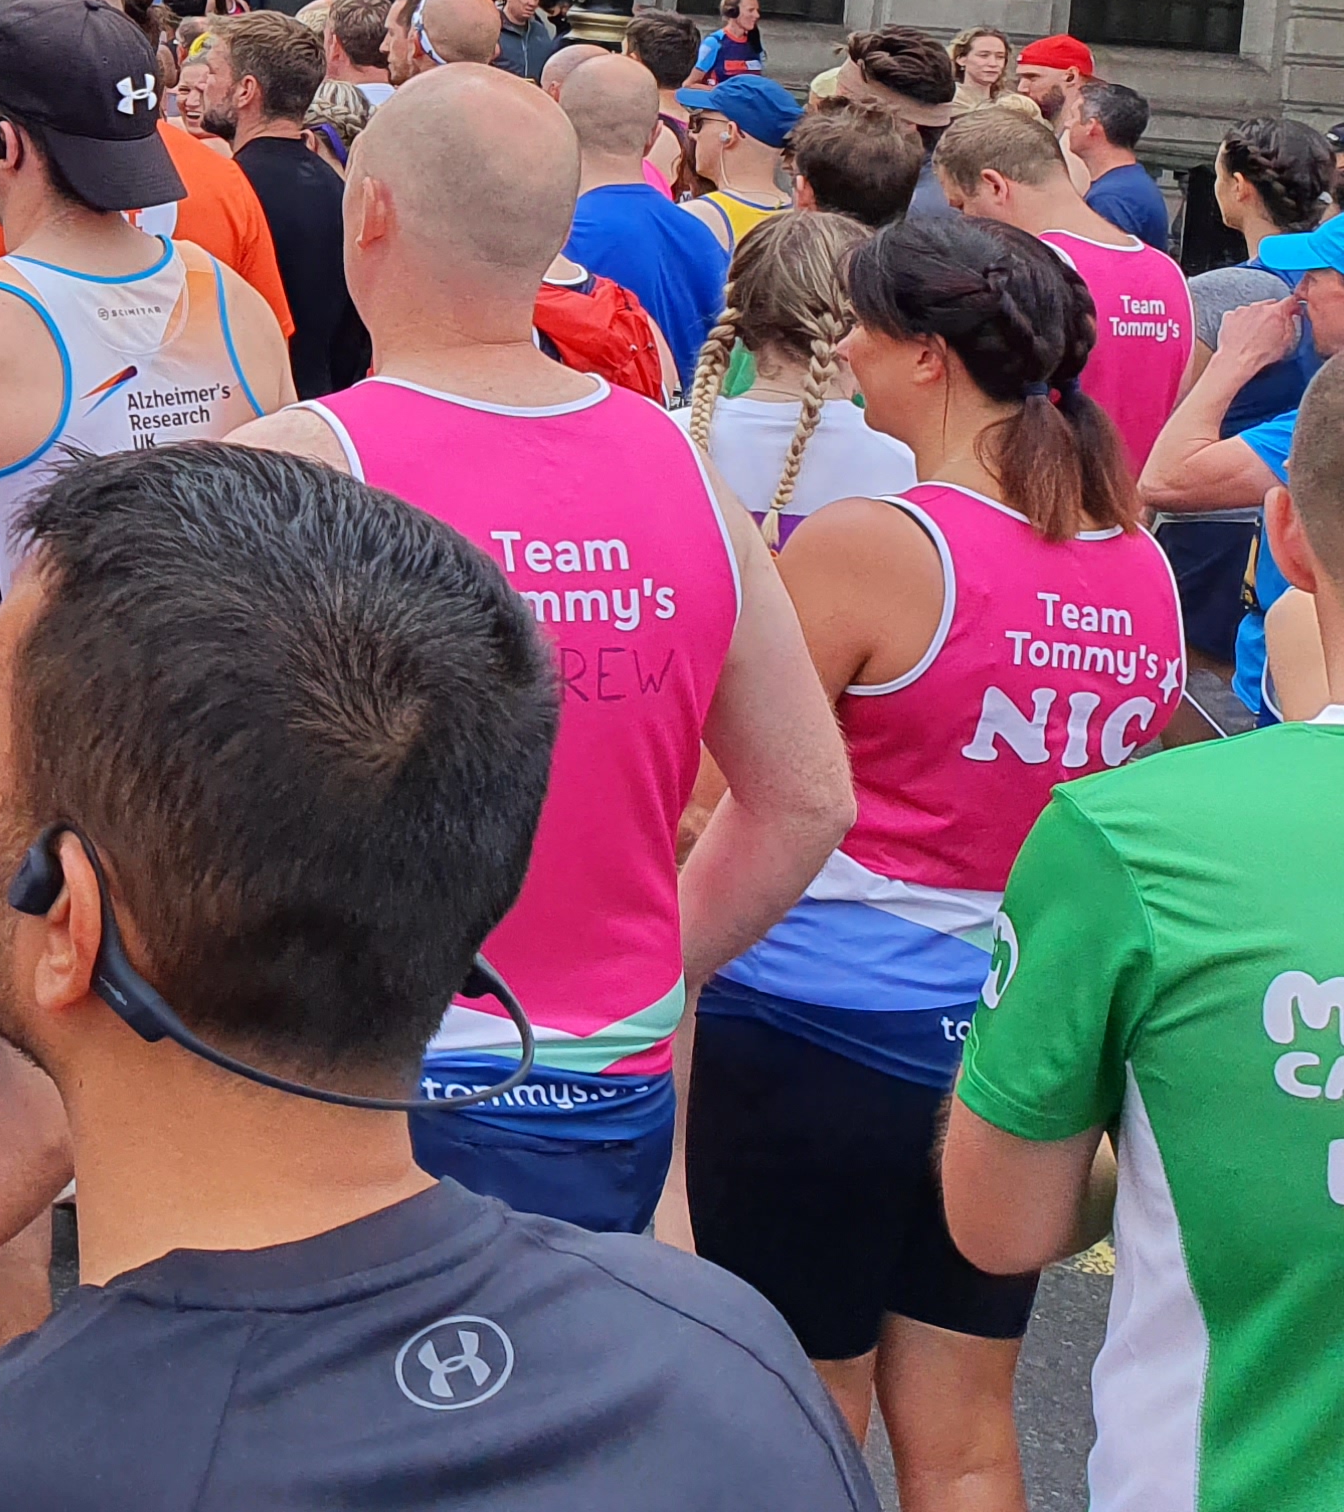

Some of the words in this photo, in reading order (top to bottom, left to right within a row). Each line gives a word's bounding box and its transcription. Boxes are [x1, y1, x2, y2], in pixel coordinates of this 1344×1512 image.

[111, 306, 162, 317] SCIMITAR
[1119, 295, 1166, 315] Team
[1108, 316, 1180, 343] Tommy's
[127, 382, 231, 411] Alzheimer's
[128, 405, 211, 431] Research
[132, 433, 158, 451] UK
[489, 530, 630, 573] Team
[1036, 591, 1133, 636] Team
[1004, 630, 1160, 685] Tommy's
[961, 685, 1157, 768] NIC
